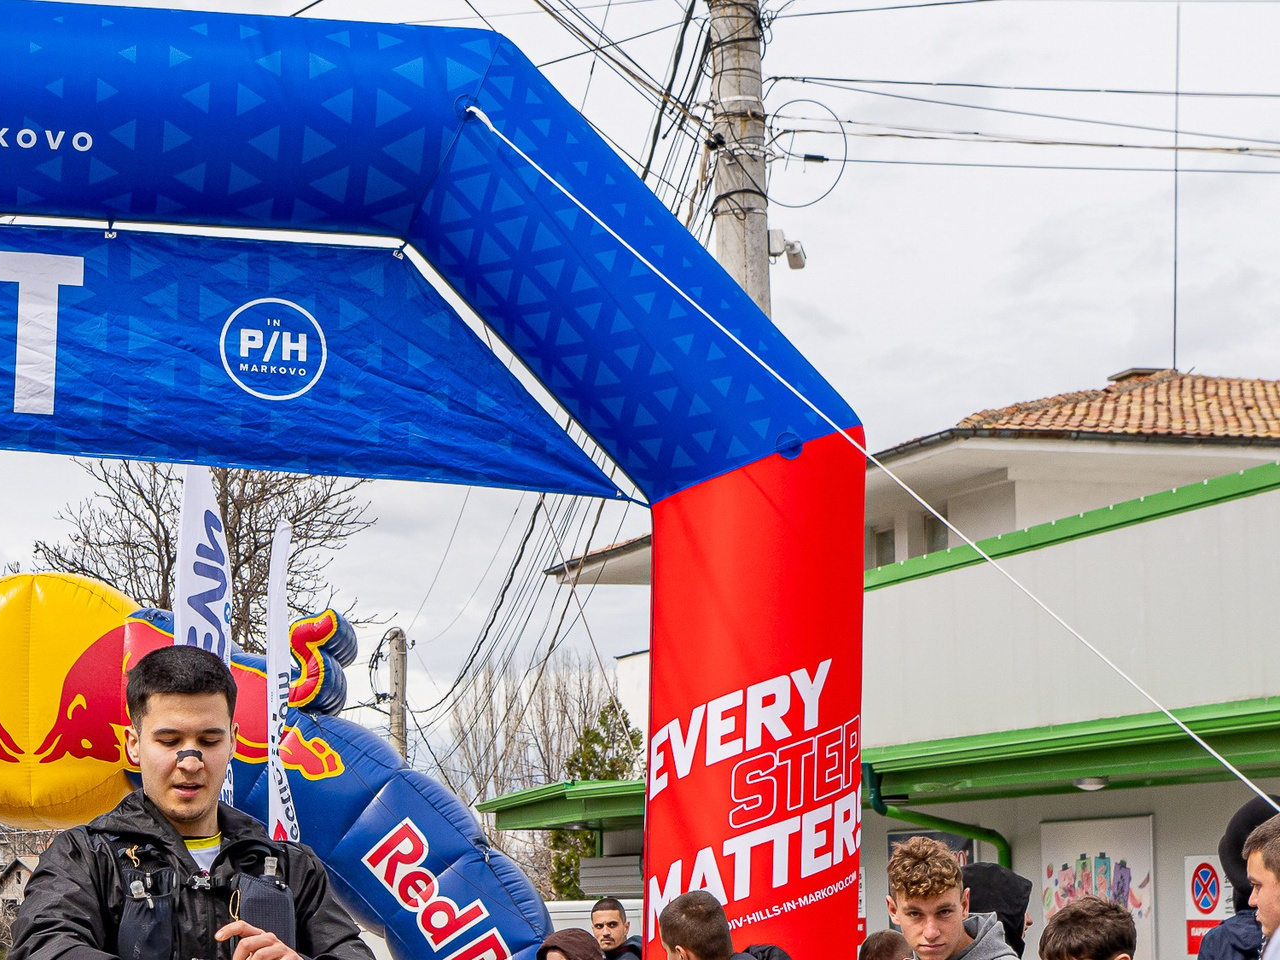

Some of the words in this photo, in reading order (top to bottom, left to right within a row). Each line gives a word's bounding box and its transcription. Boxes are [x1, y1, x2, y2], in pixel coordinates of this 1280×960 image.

[239, 328, 307, 363] P/H
[267, 318, 281, 327] IN
[239, 363, 307, 377] MARKOVO
[650, 658, 832, 801] EVERY
[729, 715, 860, 829] STEP
[367, 823, 484, 946] Red
